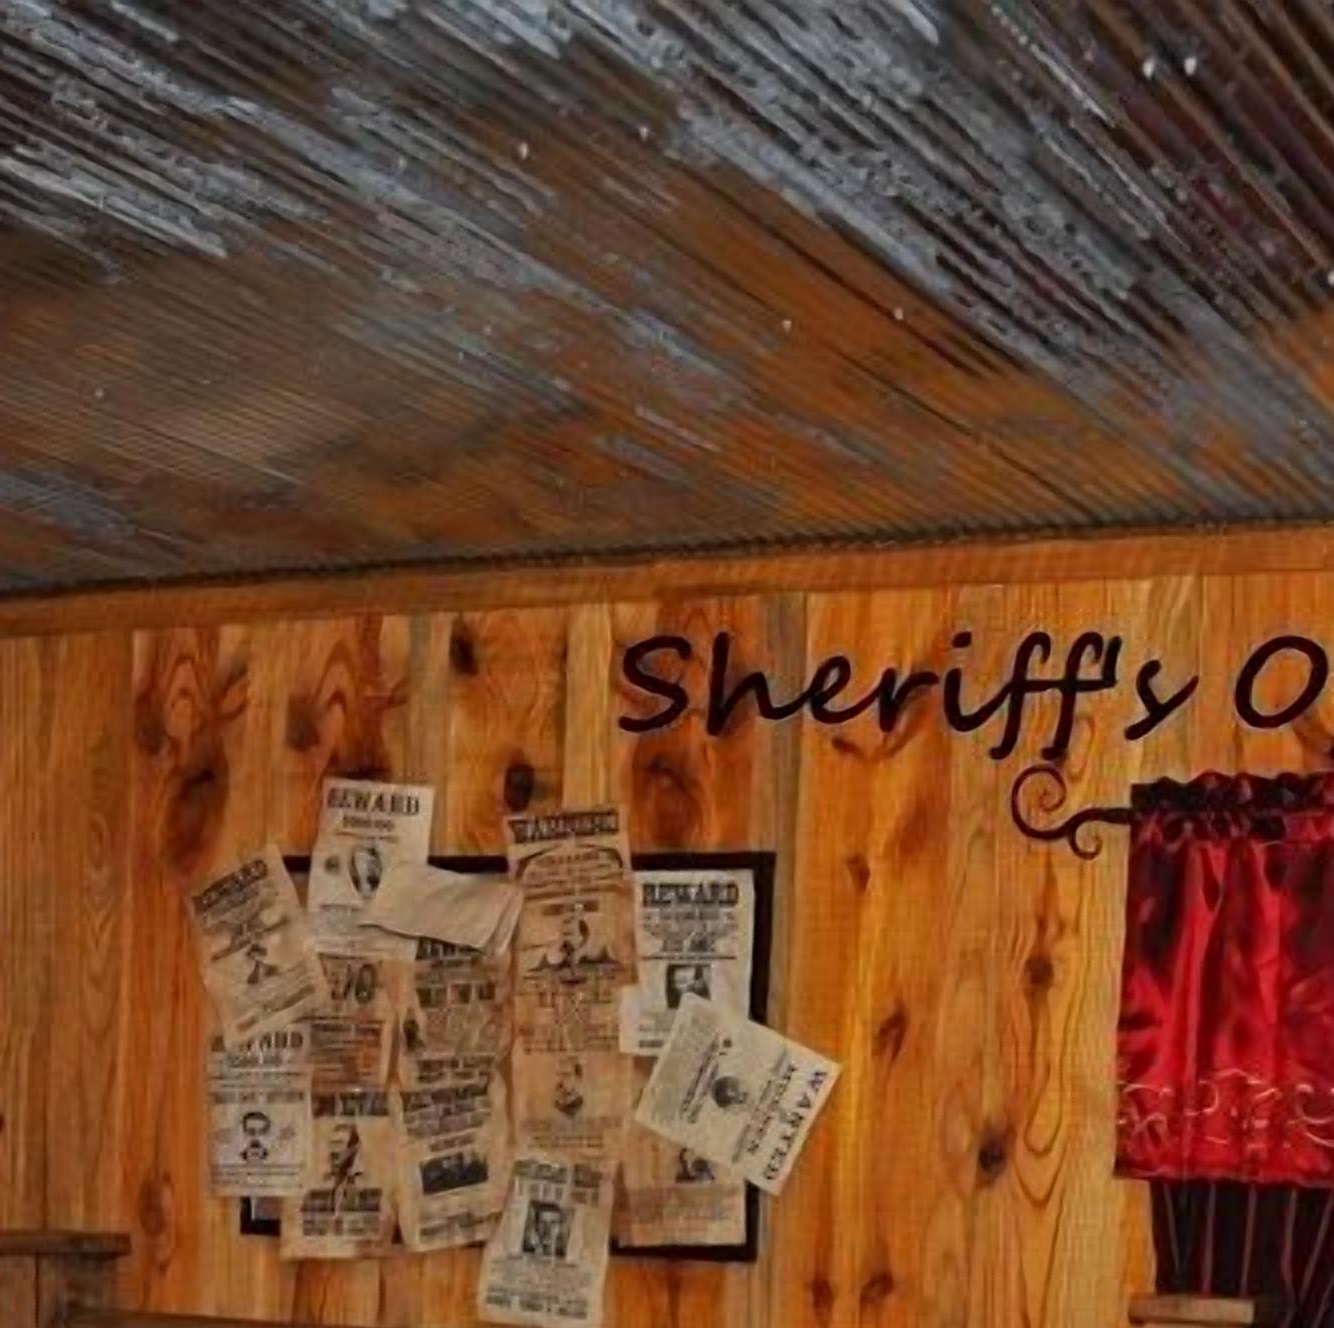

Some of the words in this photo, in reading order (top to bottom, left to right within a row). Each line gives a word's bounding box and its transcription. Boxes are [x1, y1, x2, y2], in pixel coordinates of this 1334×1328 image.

[618, 631, 1199, 760] Sheriff's
[327, 787, 419, 816] REWARD
[642, 883, 739, 908] REWARD
[763, 1065, 829, 1181] WANTED
